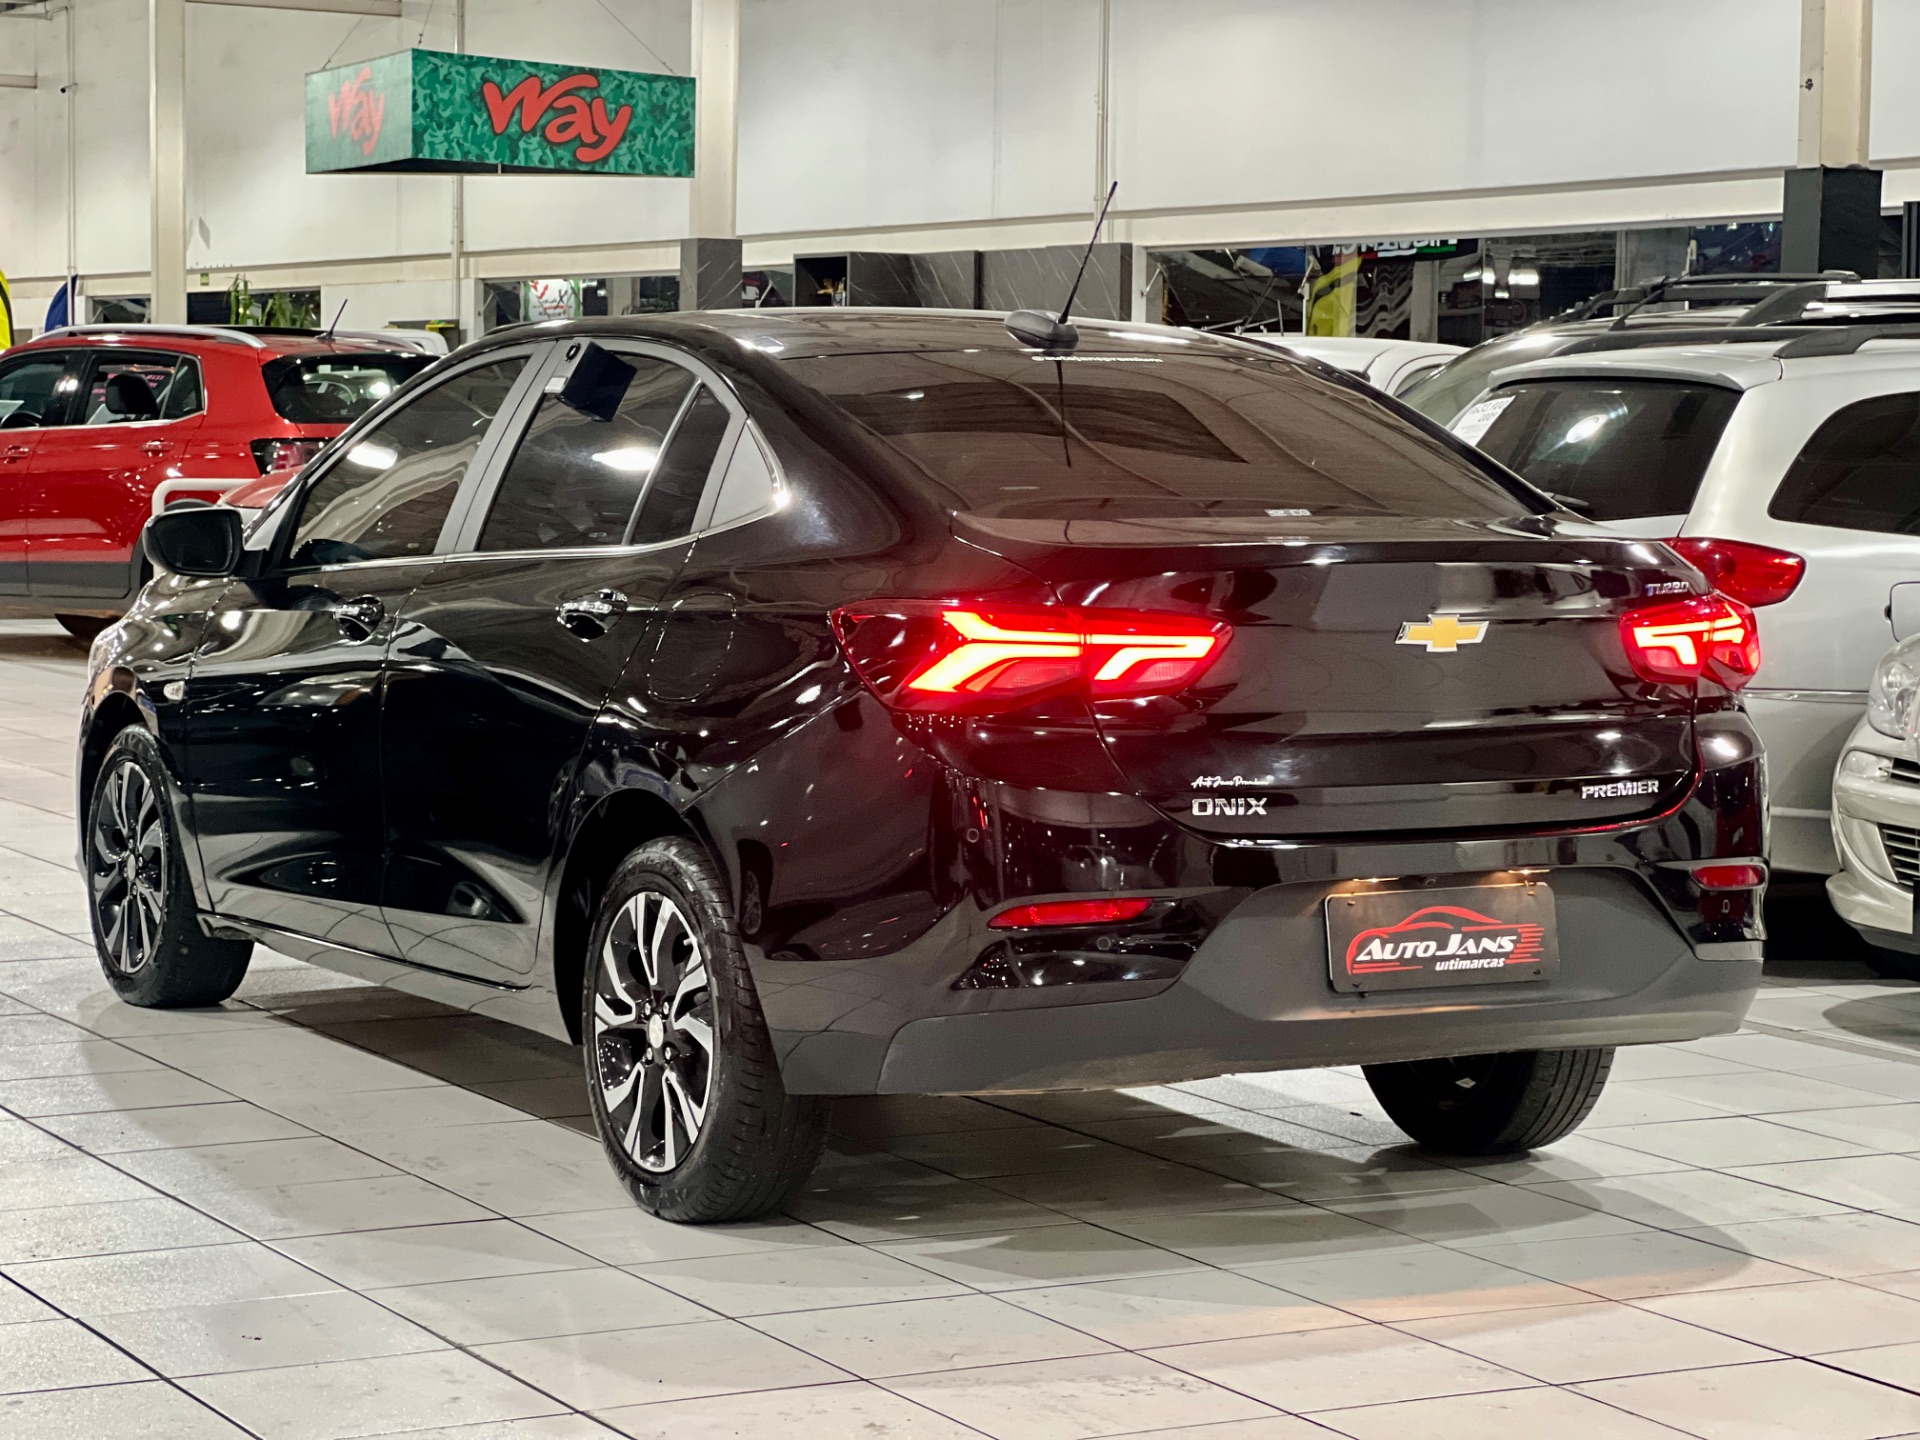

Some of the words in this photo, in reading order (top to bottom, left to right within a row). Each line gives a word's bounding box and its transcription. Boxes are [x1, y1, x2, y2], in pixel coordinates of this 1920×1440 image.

[1645, 581, 1689, 597] TURBO
[1581, 780, 1660, 799] PREMIER
[1192, 797, 1268, 816] ONIX
